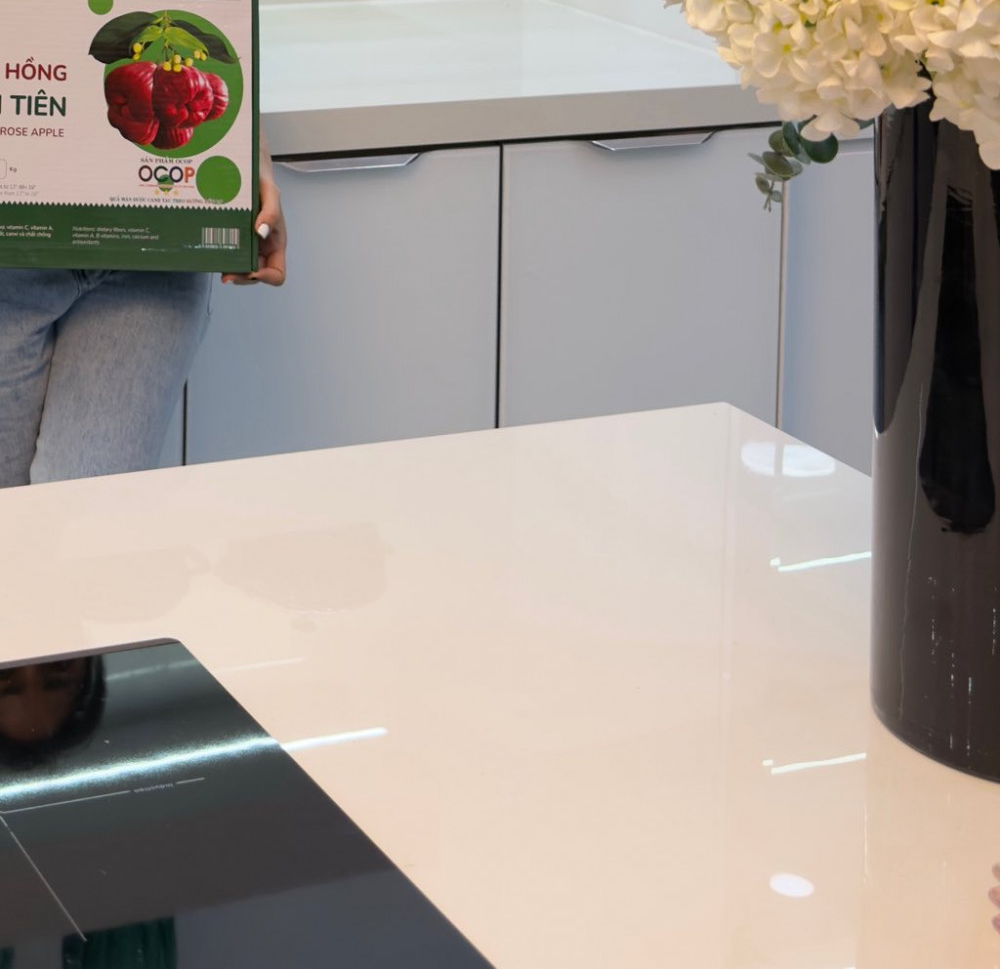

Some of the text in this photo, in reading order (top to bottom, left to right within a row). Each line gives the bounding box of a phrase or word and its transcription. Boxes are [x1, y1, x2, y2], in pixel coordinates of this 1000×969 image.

[5, 56, 67, 81] HỒNG
[10, 89, 66, 117] TIÊN
[0, 126, 28, 136] ROSE
[31, 127, 64, 137] APPLE
[138, 165, 195, 183] OCOP
